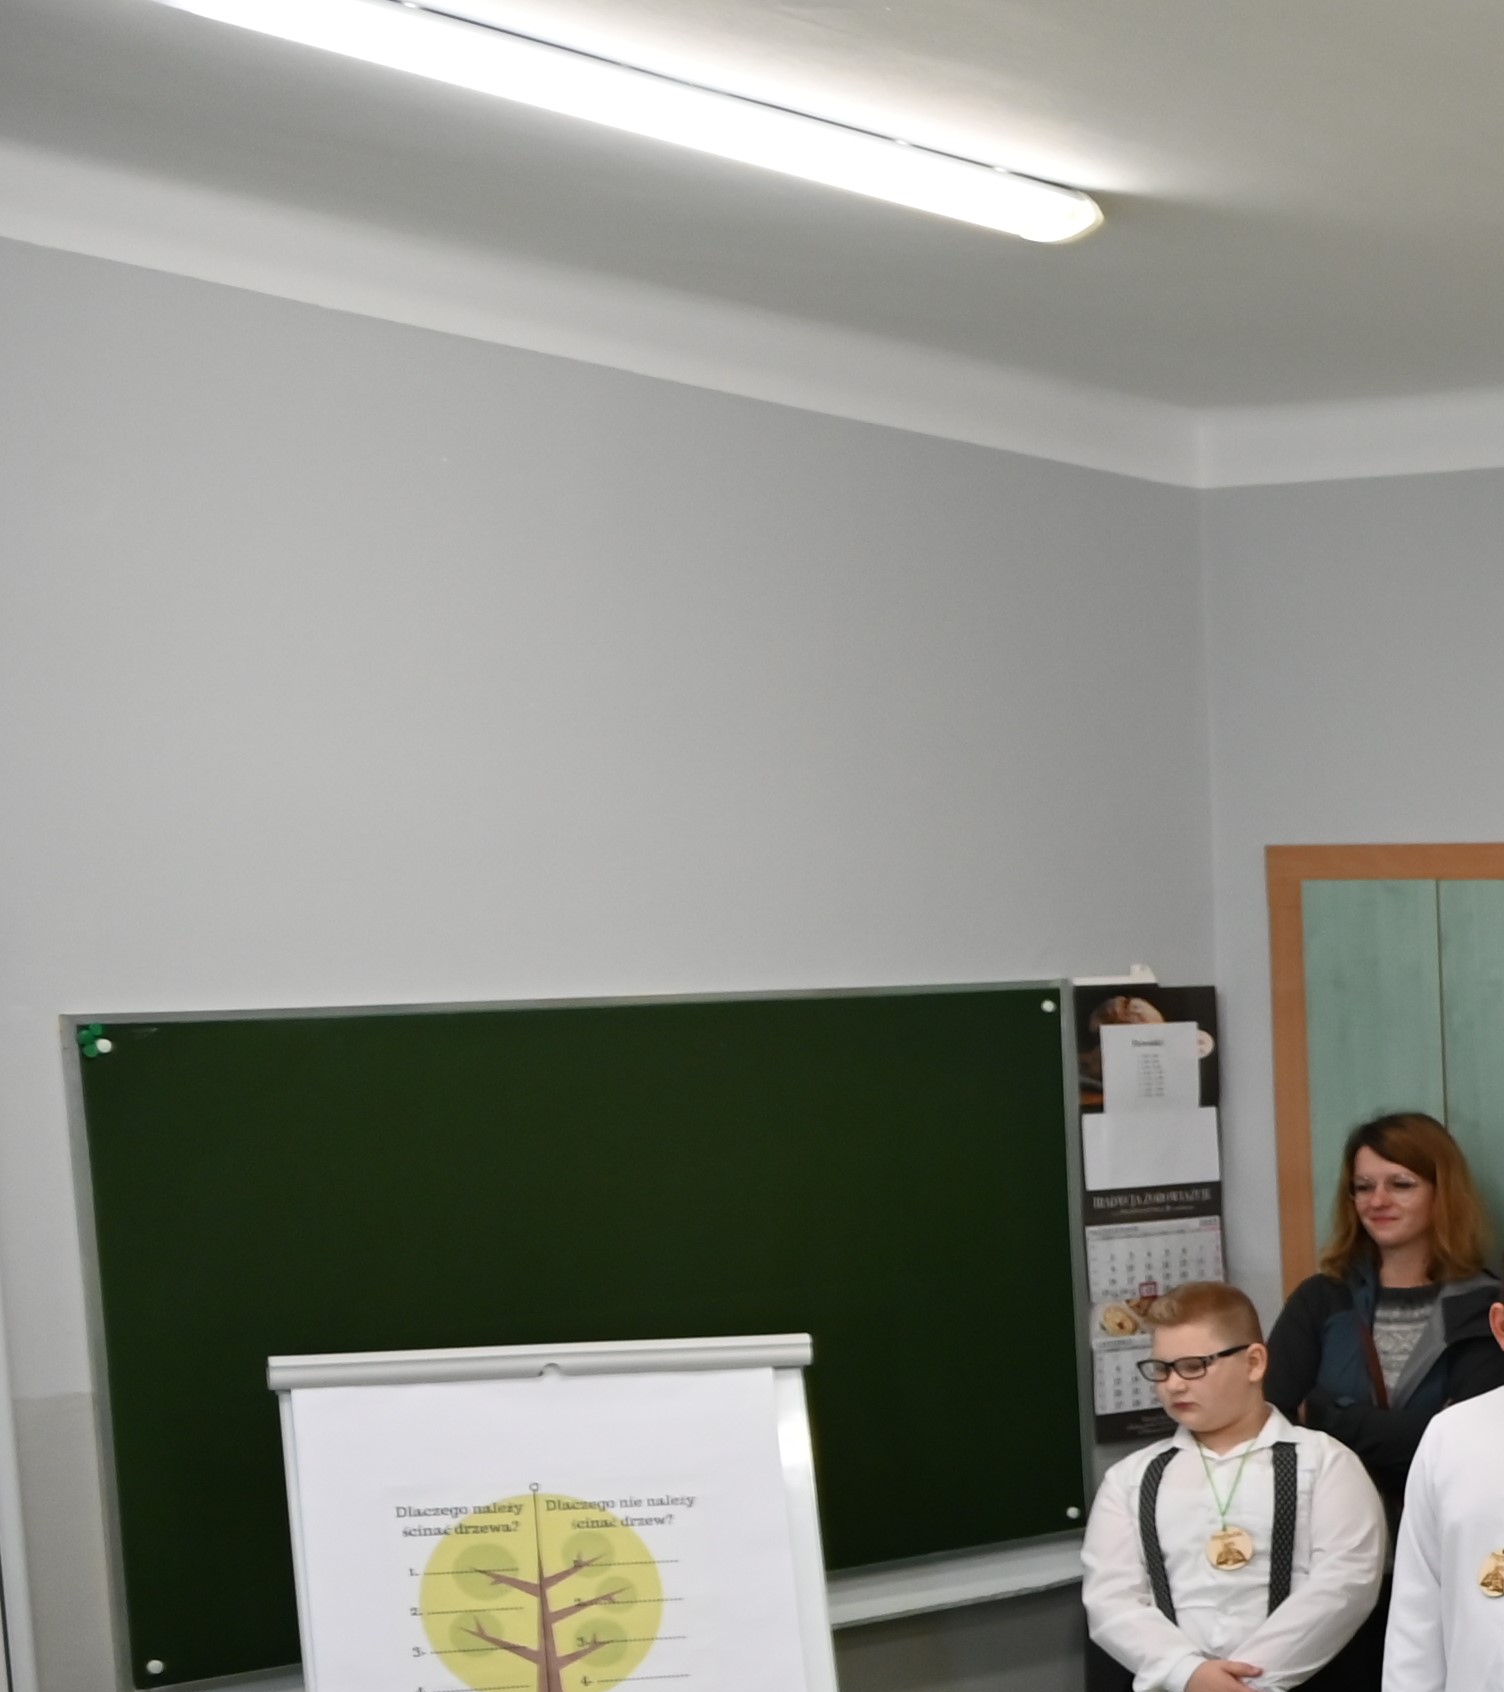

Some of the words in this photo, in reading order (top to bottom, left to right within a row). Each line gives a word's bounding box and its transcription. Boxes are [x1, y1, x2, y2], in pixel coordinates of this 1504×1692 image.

[396, 1504, 468, 1519] Dlaczego
[473, 1501, 523, 1517] należy
[545, 1497, 616, 1513] Dlaczego
[620, 1496, 642, 1508] nie
[646, 1494, 696, 1509] należy
[621, 1514, 675, 1527] drzew?
[402, 1524, 451, 1539] ścinać
[454, 1521, 519, 1536] drzewa?
